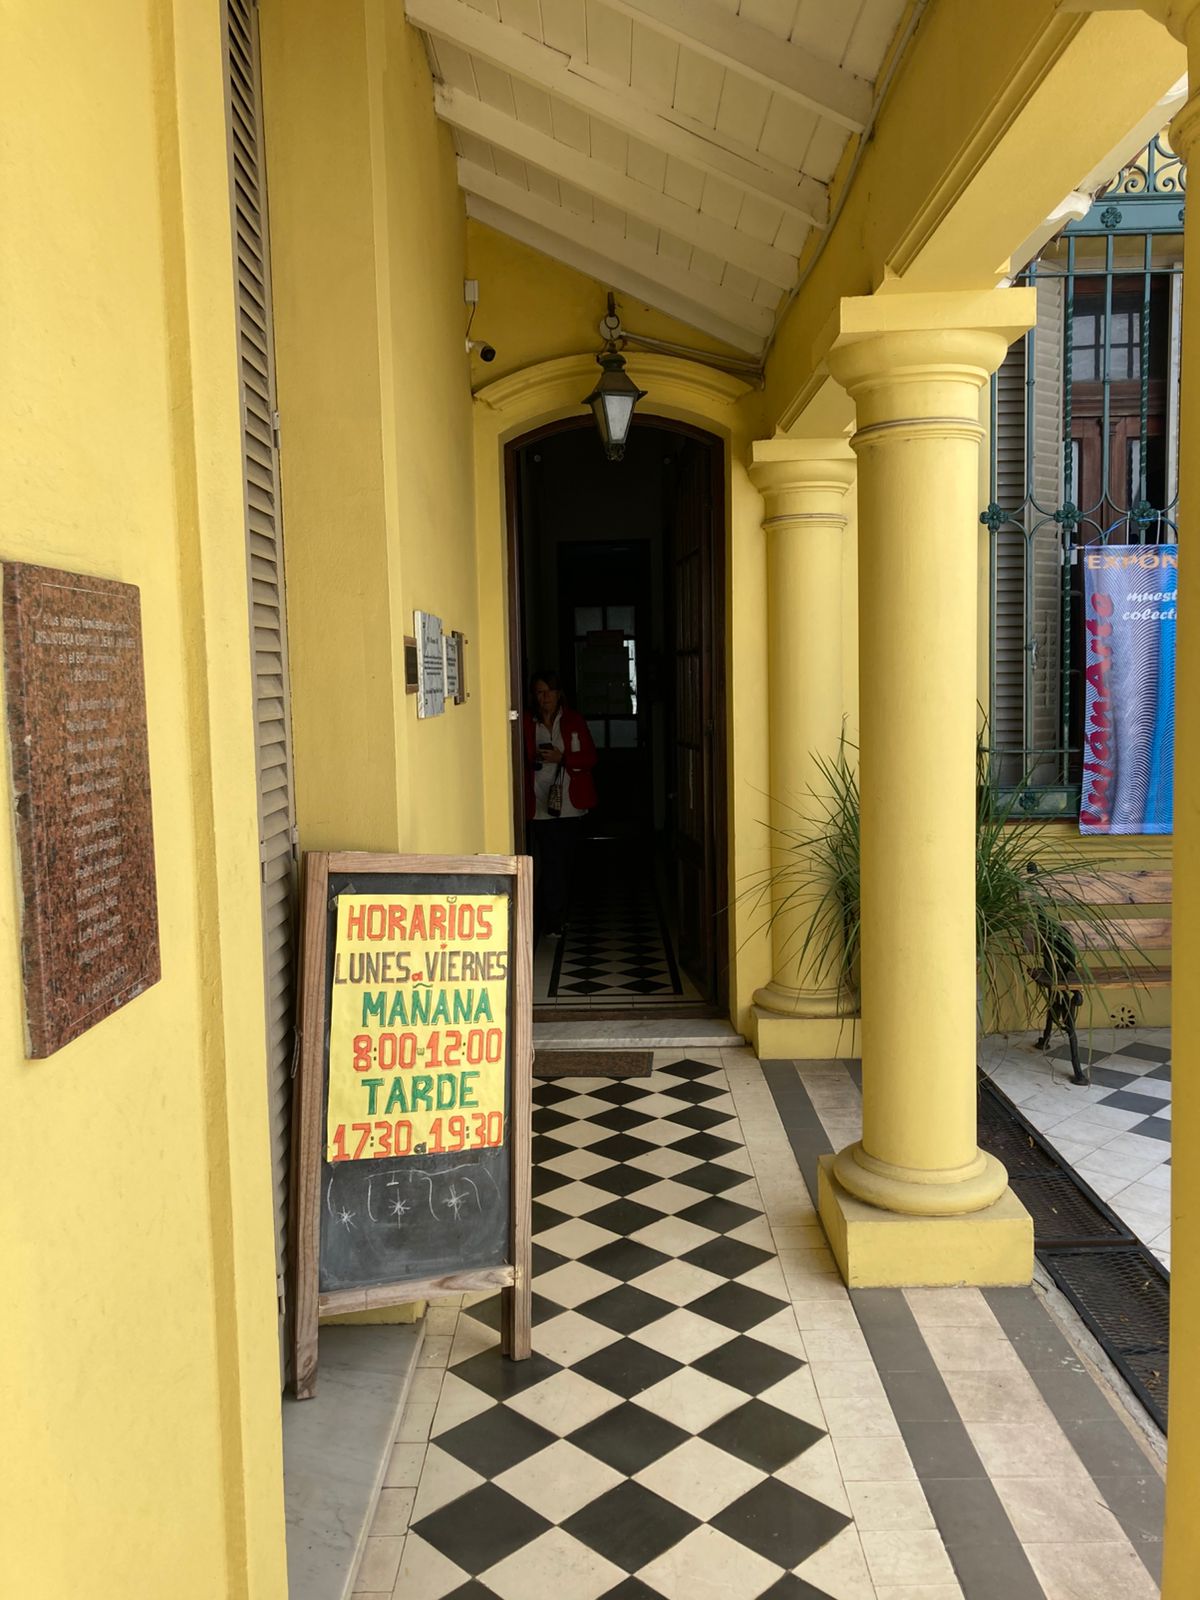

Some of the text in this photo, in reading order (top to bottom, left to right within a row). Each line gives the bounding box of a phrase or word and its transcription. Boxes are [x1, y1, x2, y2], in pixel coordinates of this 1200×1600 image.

[347, 897, 493, 941] HORARIOS
[335, 944, 508, 984] LUNES a VIERNES
[361, 982, 494, 1028] MAÑANA
[361, 1071, 480, 1115] TARDE
[332, 1111, 503, 1161] 17:30 a 19:30
